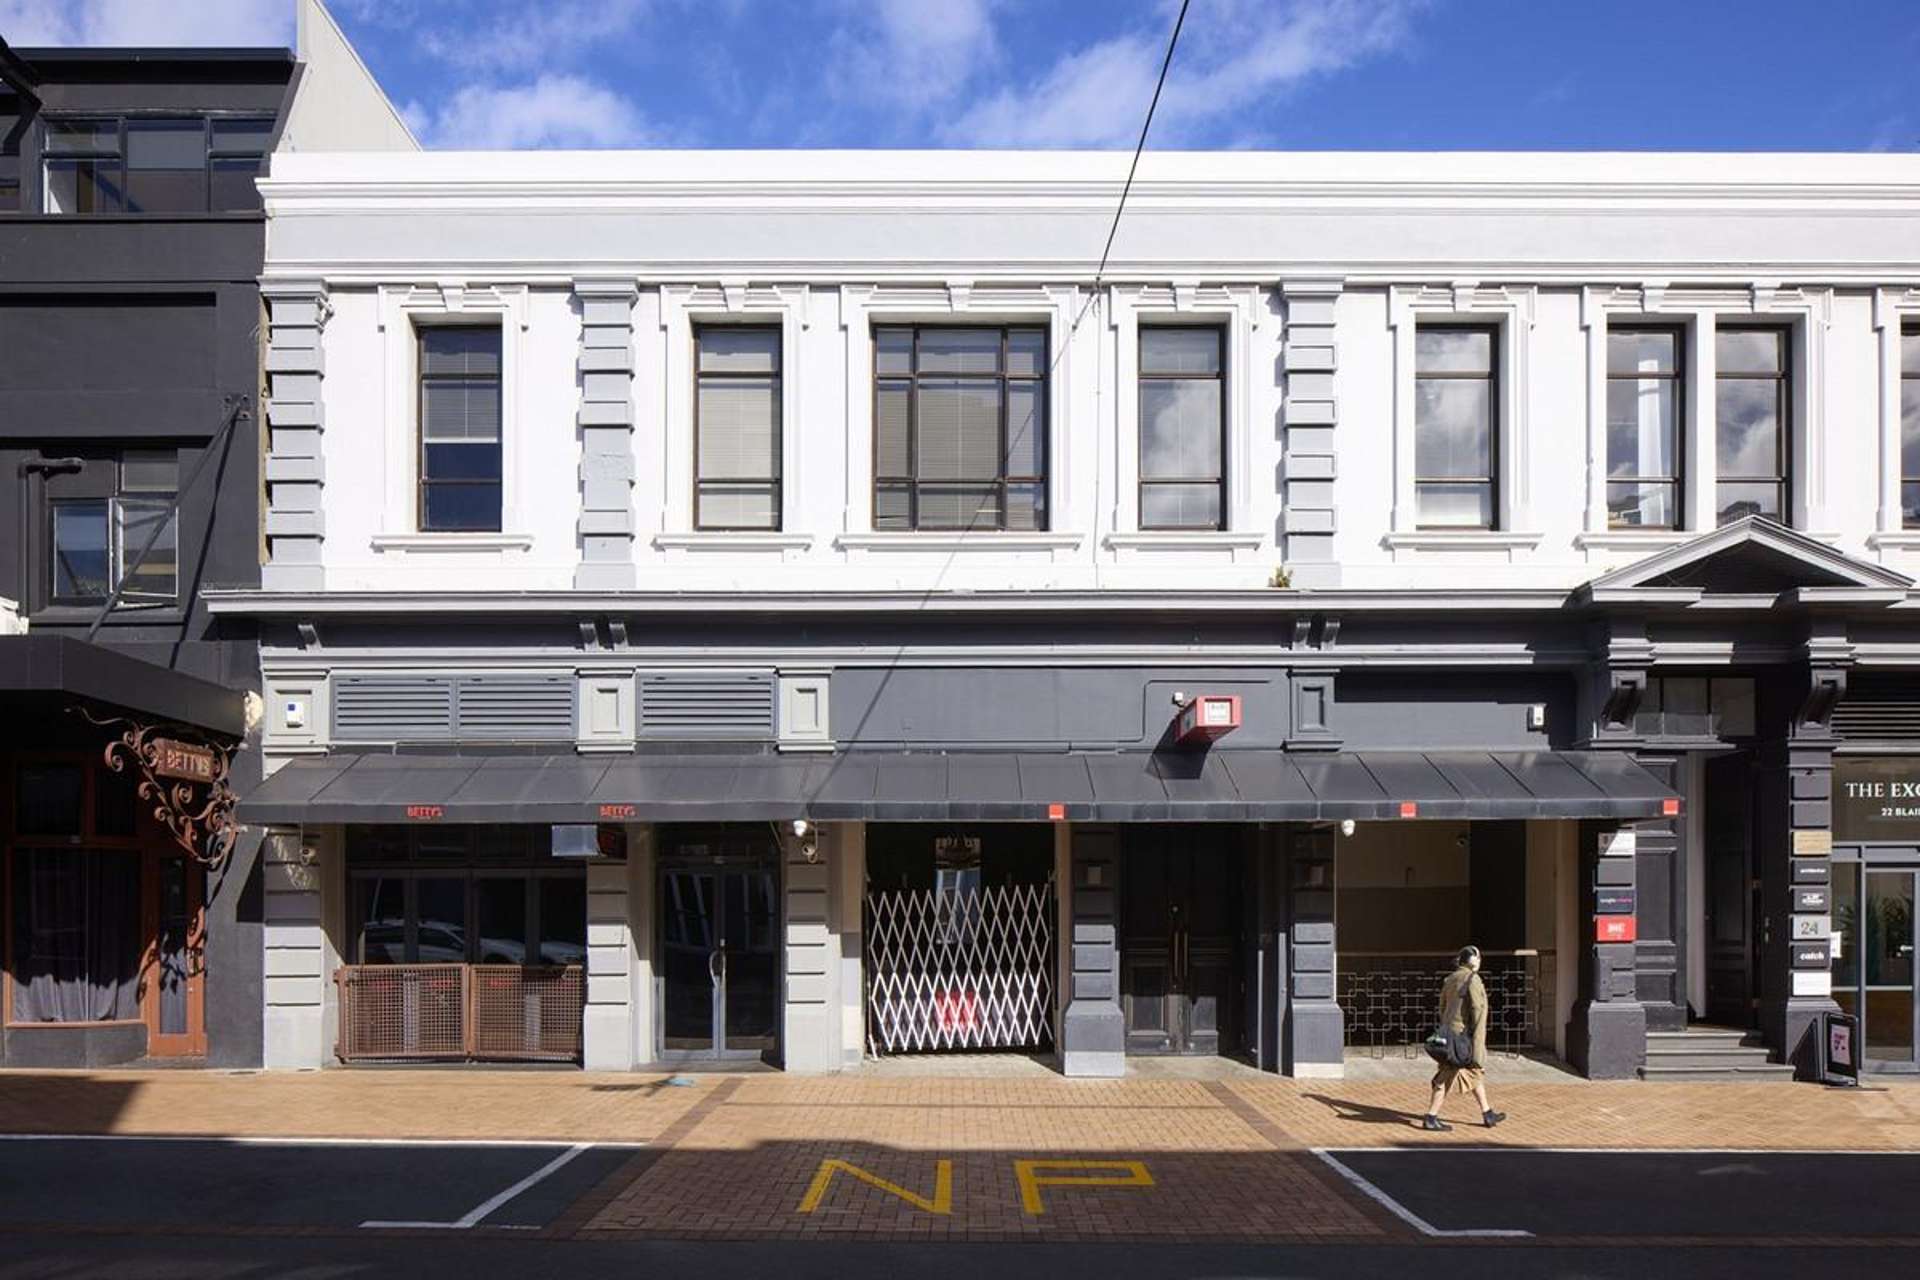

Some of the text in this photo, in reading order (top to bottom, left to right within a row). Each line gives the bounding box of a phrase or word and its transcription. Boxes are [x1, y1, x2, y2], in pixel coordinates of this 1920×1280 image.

[1845, 783, 1884, 798] THE
[1881, 807, 1893, 816] 22
[1800, 921, 1819, 935] 24
